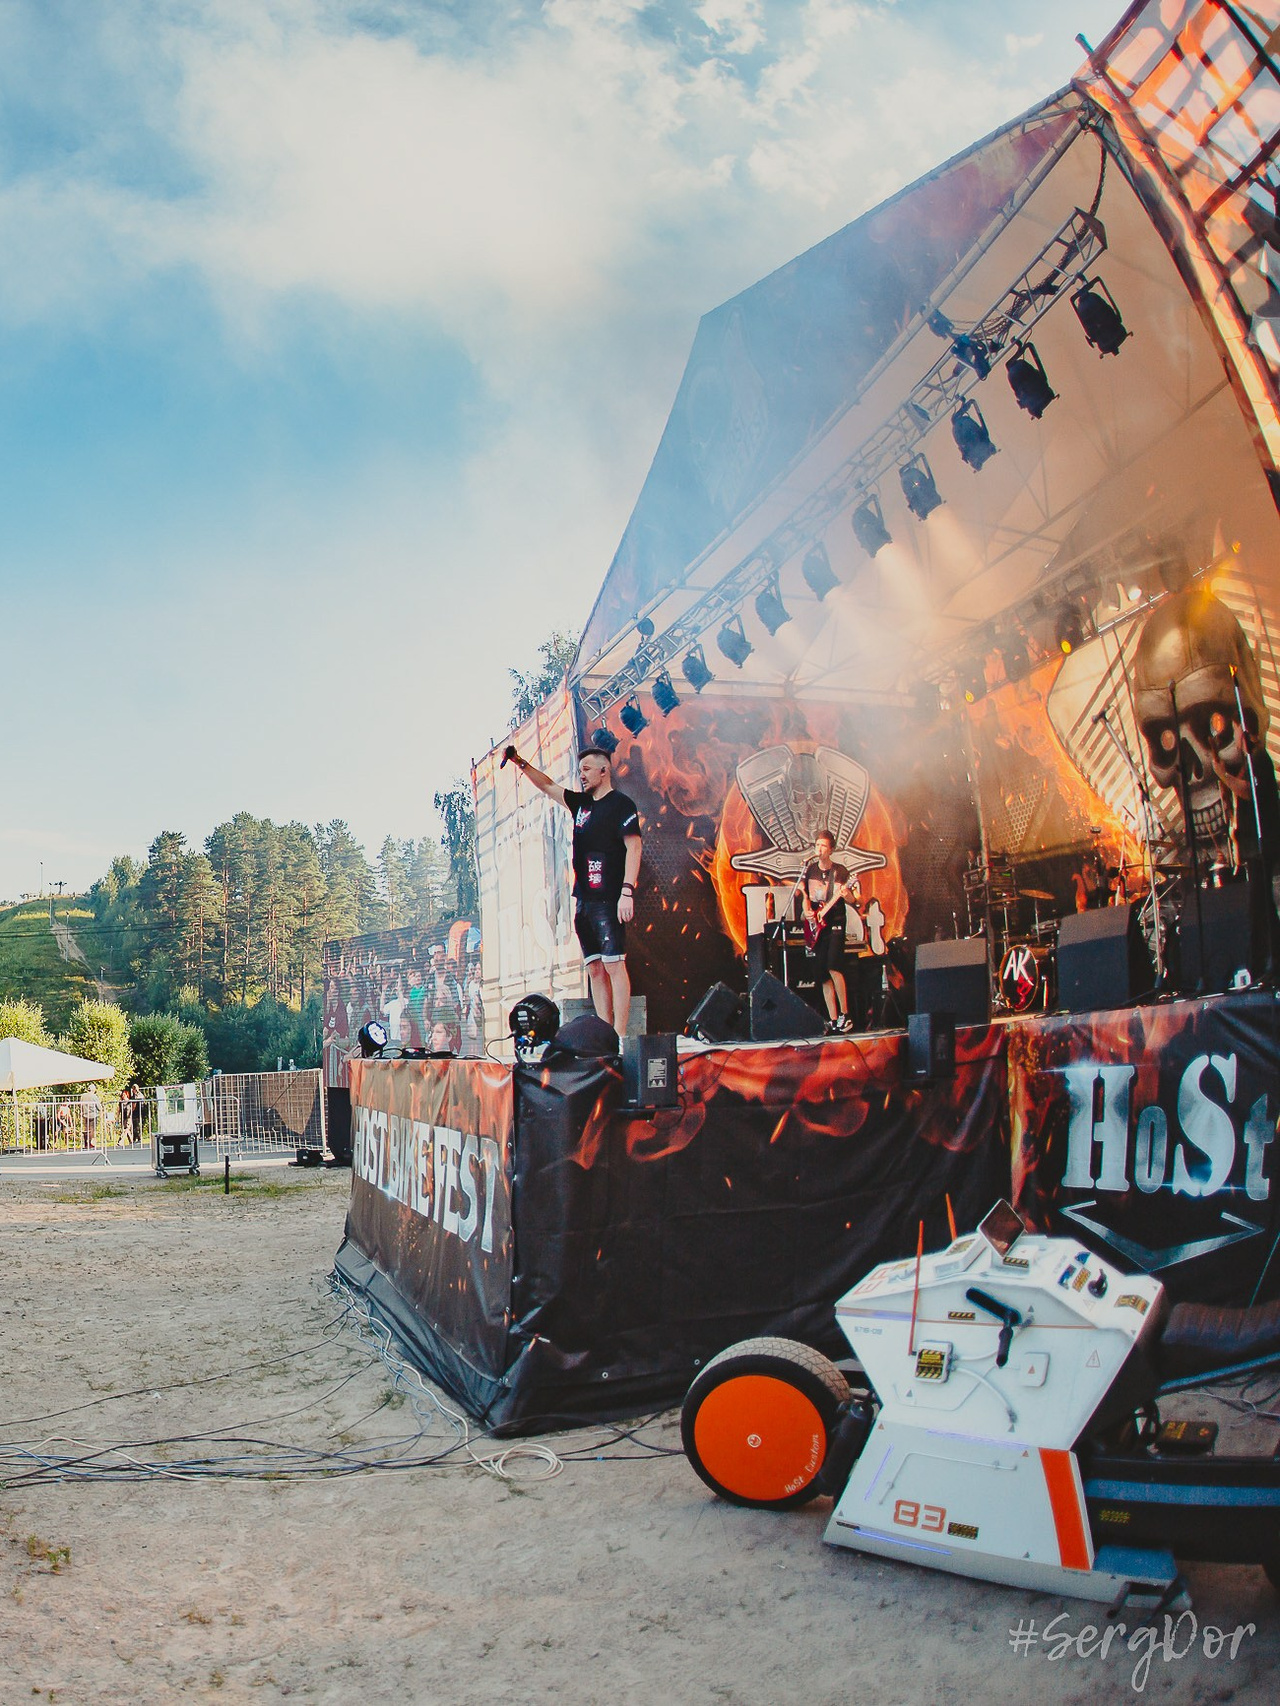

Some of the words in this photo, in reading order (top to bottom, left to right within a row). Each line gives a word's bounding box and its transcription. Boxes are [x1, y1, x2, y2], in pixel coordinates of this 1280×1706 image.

[1003, 949, 1034, 986] AK
[1061, 1053, 1275, 1200] HoSt
[354, 1105, 388, 1191] HOST
[389, 1114, 431, 1218] BIKE
[432, 1126, 499, 1253] FEST
[804, 1434, 820, 1473] Custom
[893, 1499, 947, 1533] 83
